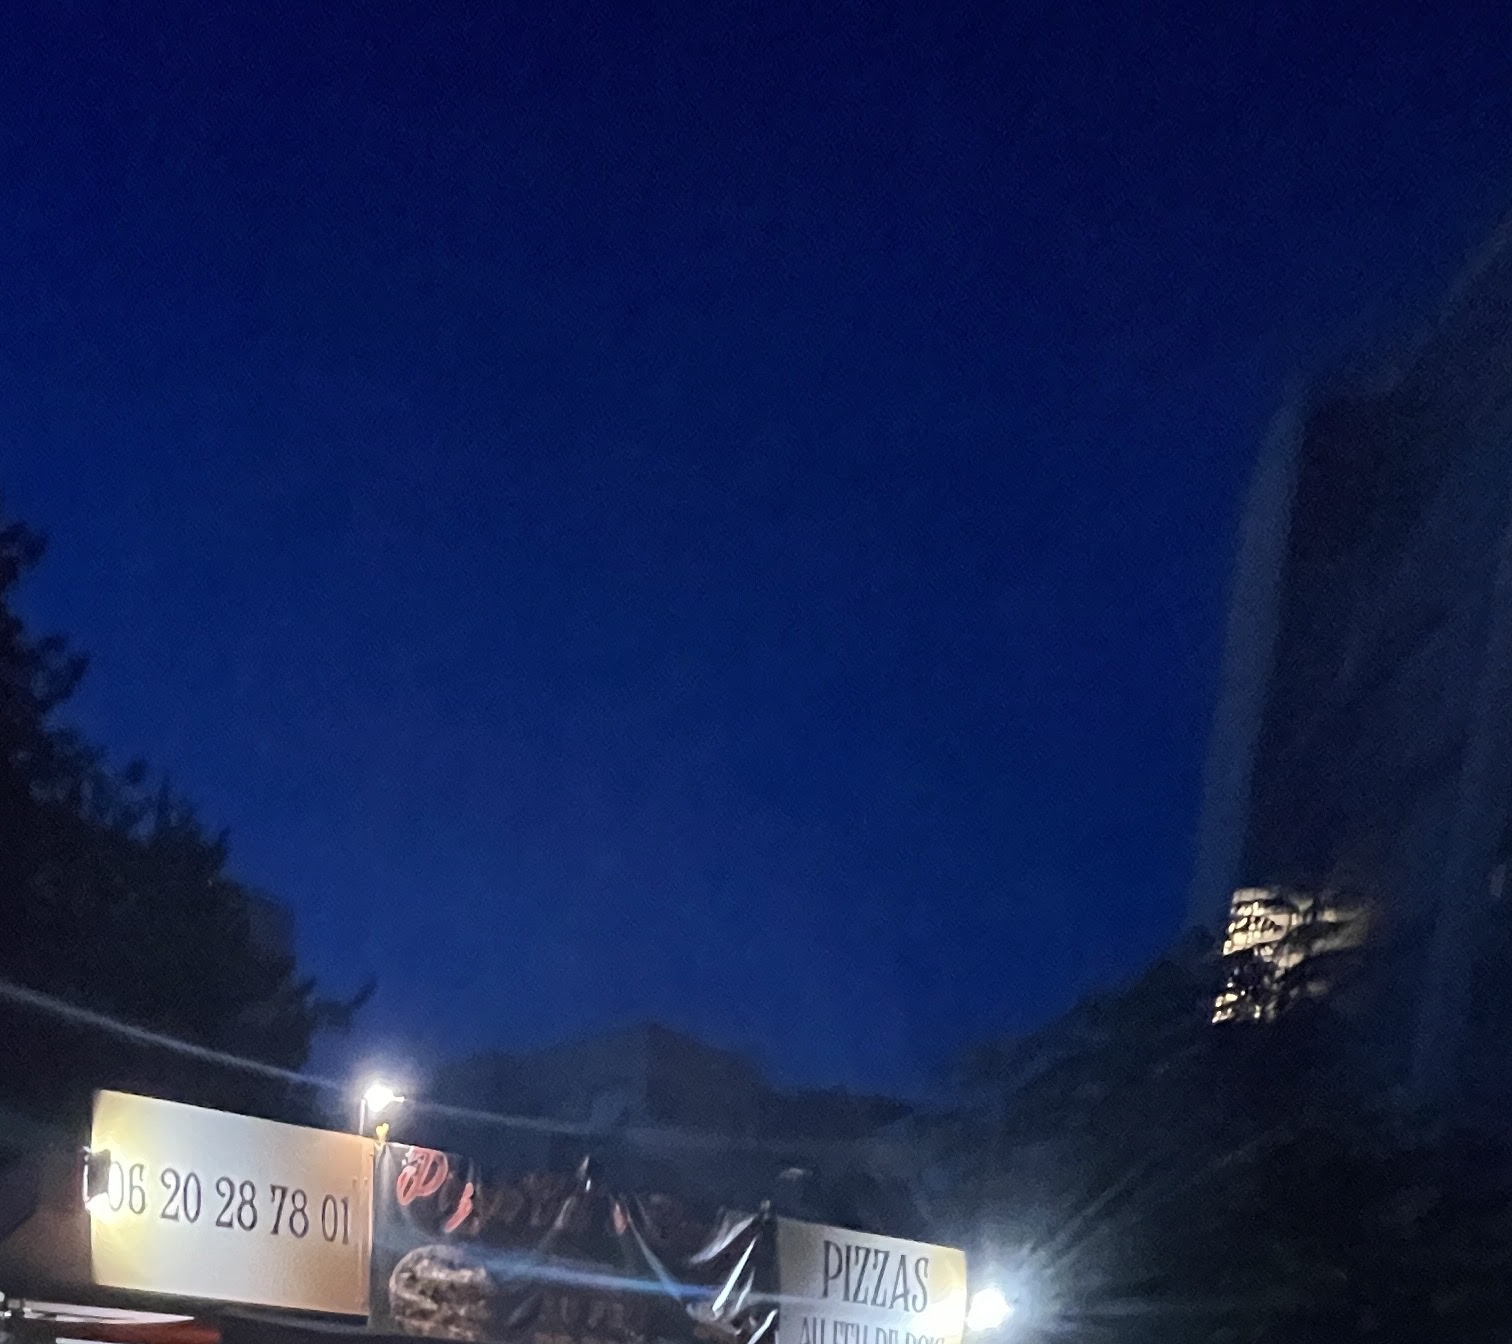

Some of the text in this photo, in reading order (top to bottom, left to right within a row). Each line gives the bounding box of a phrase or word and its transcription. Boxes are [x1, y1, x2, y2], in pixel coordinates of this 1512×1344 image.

[107, 1159, 146, 1214] 06
[160, 1167, 201, 1223] 20
[215, 1175, 258, 1232] 28
[269, 1183, 310, 1239] 78
[321, 1194, 349, 1245] 01
[821, 1240, 930, 1313] PIZZAS
